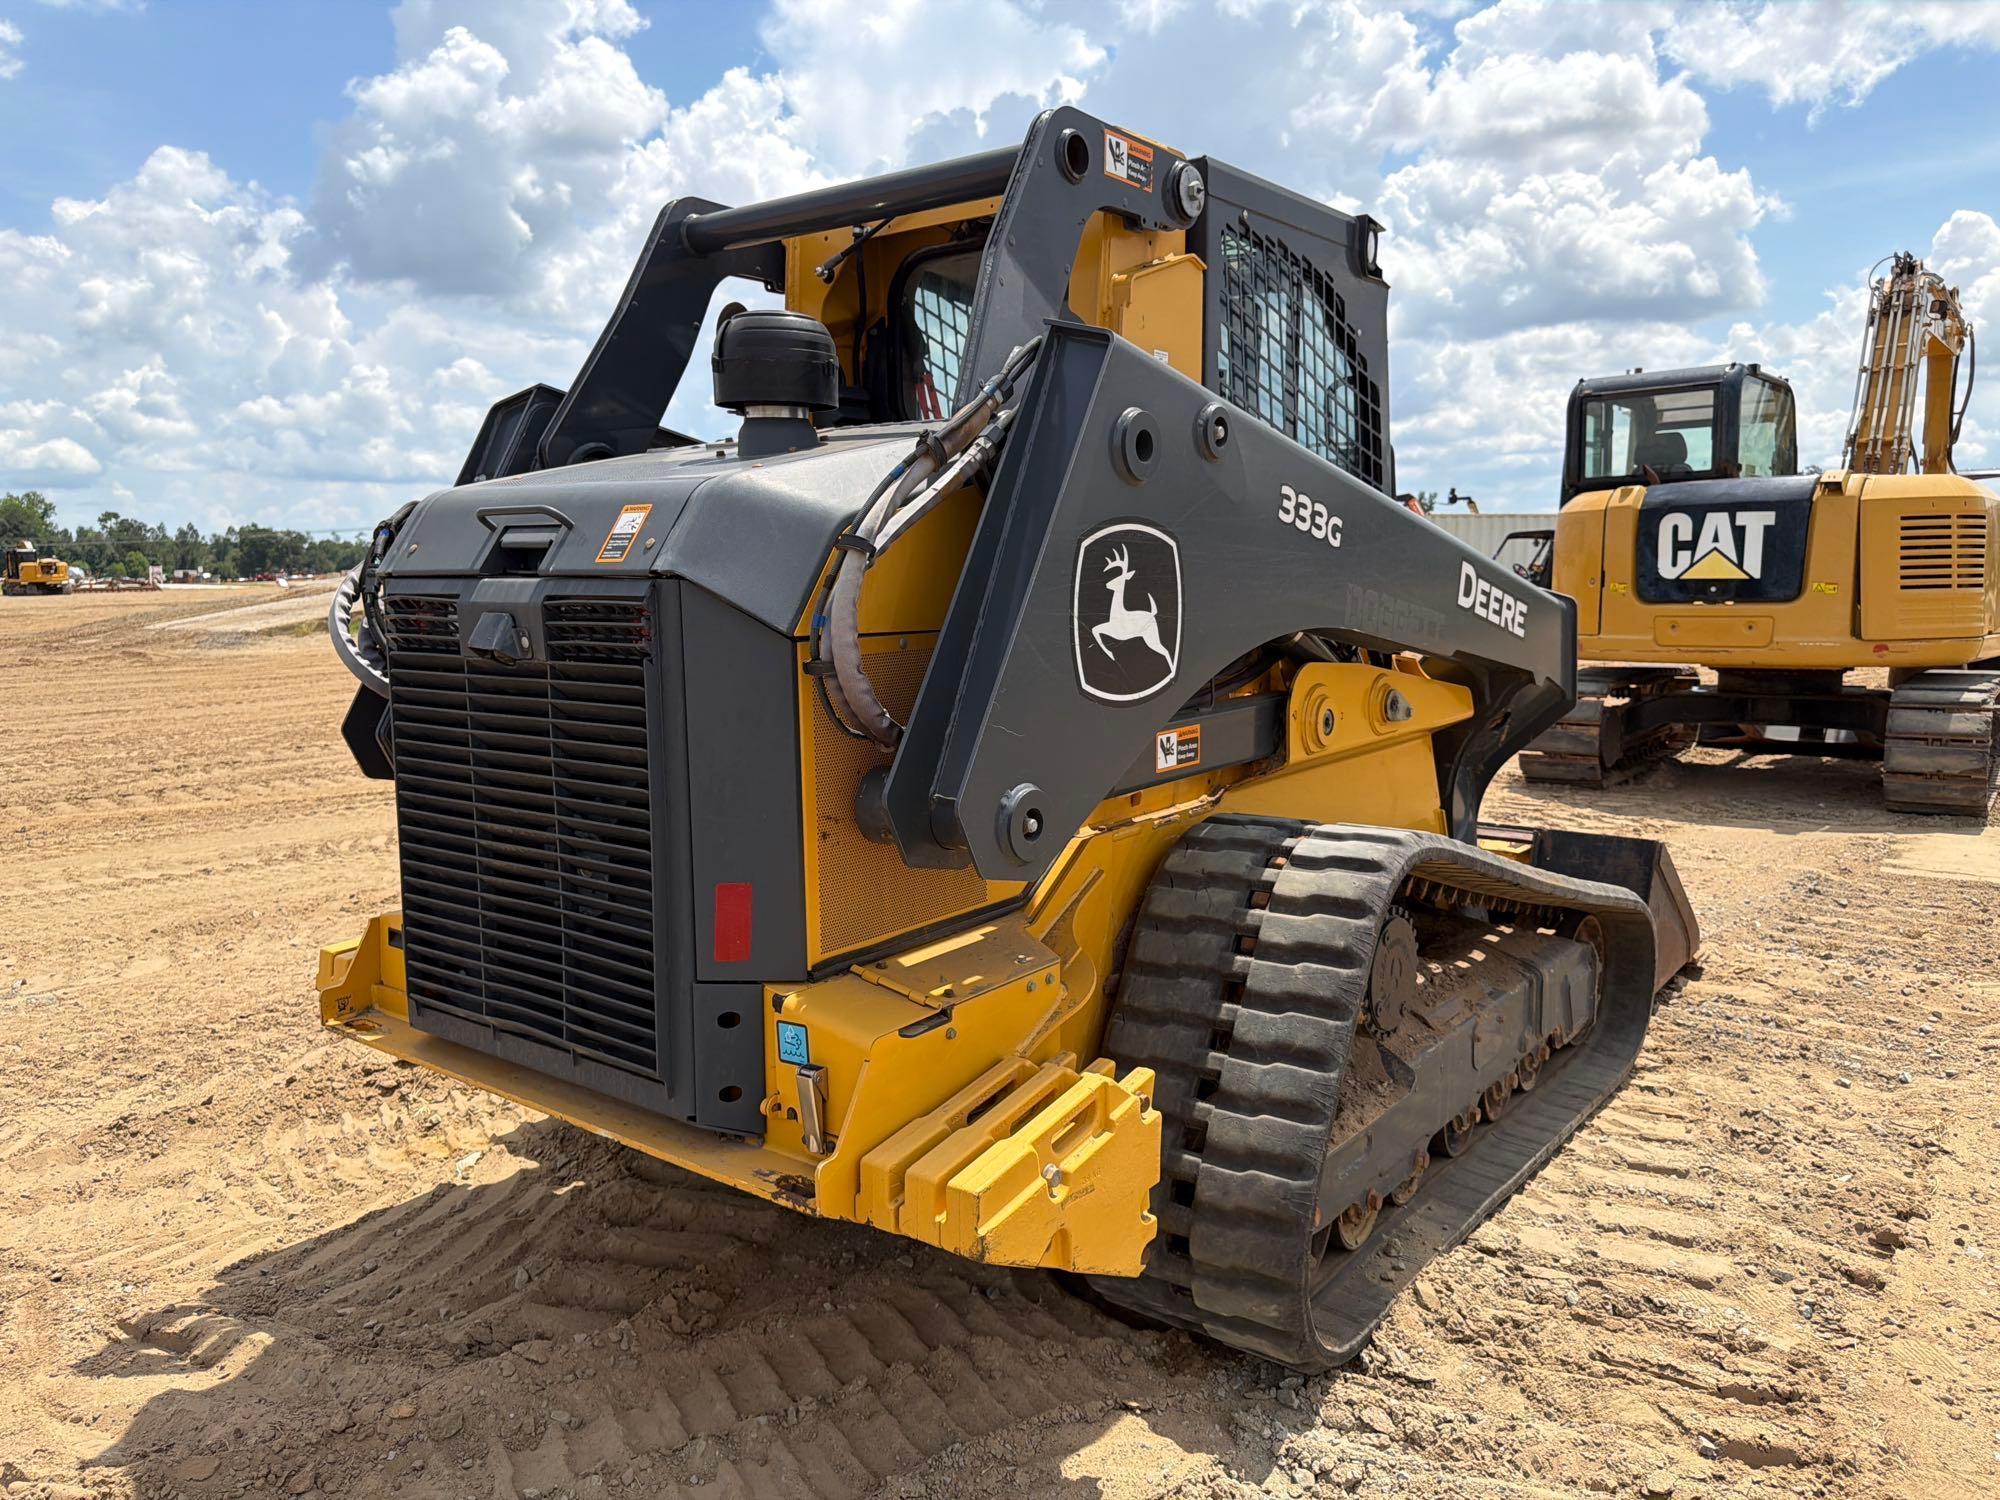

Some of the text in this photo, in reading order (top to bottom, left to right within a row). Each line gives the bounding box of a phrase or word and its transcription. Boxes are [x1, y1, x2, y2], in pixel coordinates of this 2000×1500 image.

[1278, 485, 1343, 548] 333G
[1657, 511, 1776, 580] CAT
[1457, 560, 1528, 639] DEERE
